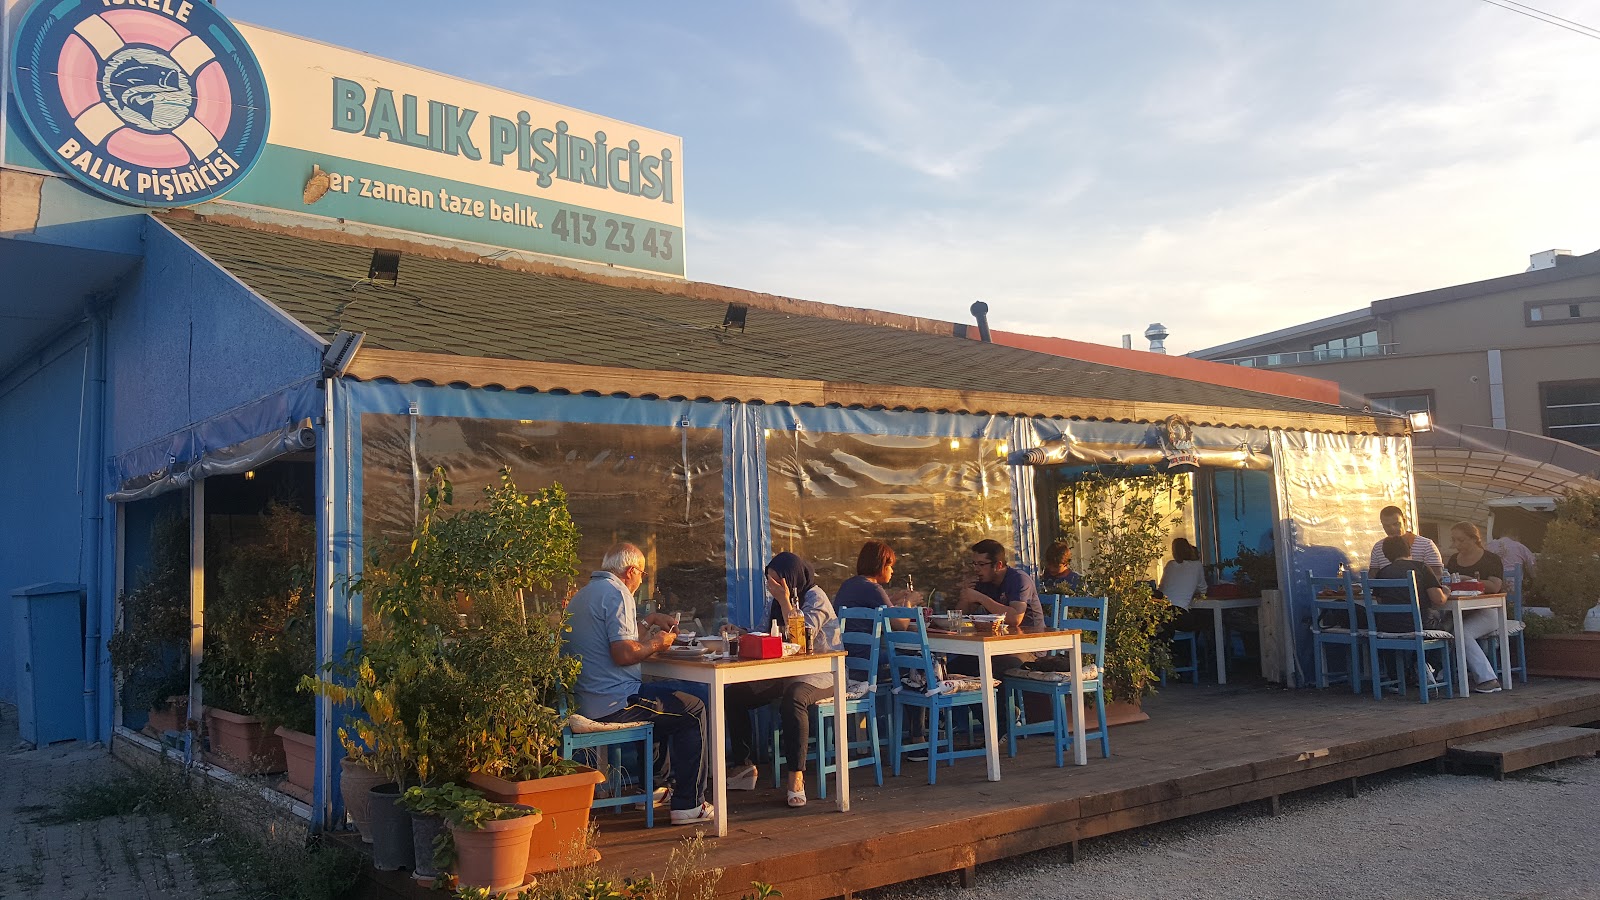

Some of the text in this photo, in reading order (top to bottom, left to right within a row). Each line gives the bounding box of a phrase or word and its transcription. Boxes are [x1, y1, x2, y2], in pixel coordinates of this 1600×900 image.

[331, 76, 674, 204] BALIK PİŞİRİCİSİ
[57, 138, 240, 201] BALIK PİŞİRİCİSİ
[358, 177, 434, 210] zaman
[439, 188, 485, 218] taze
[490, 198, 544, 229] balık.
[551, 209, 673, 261] 413 23 43
